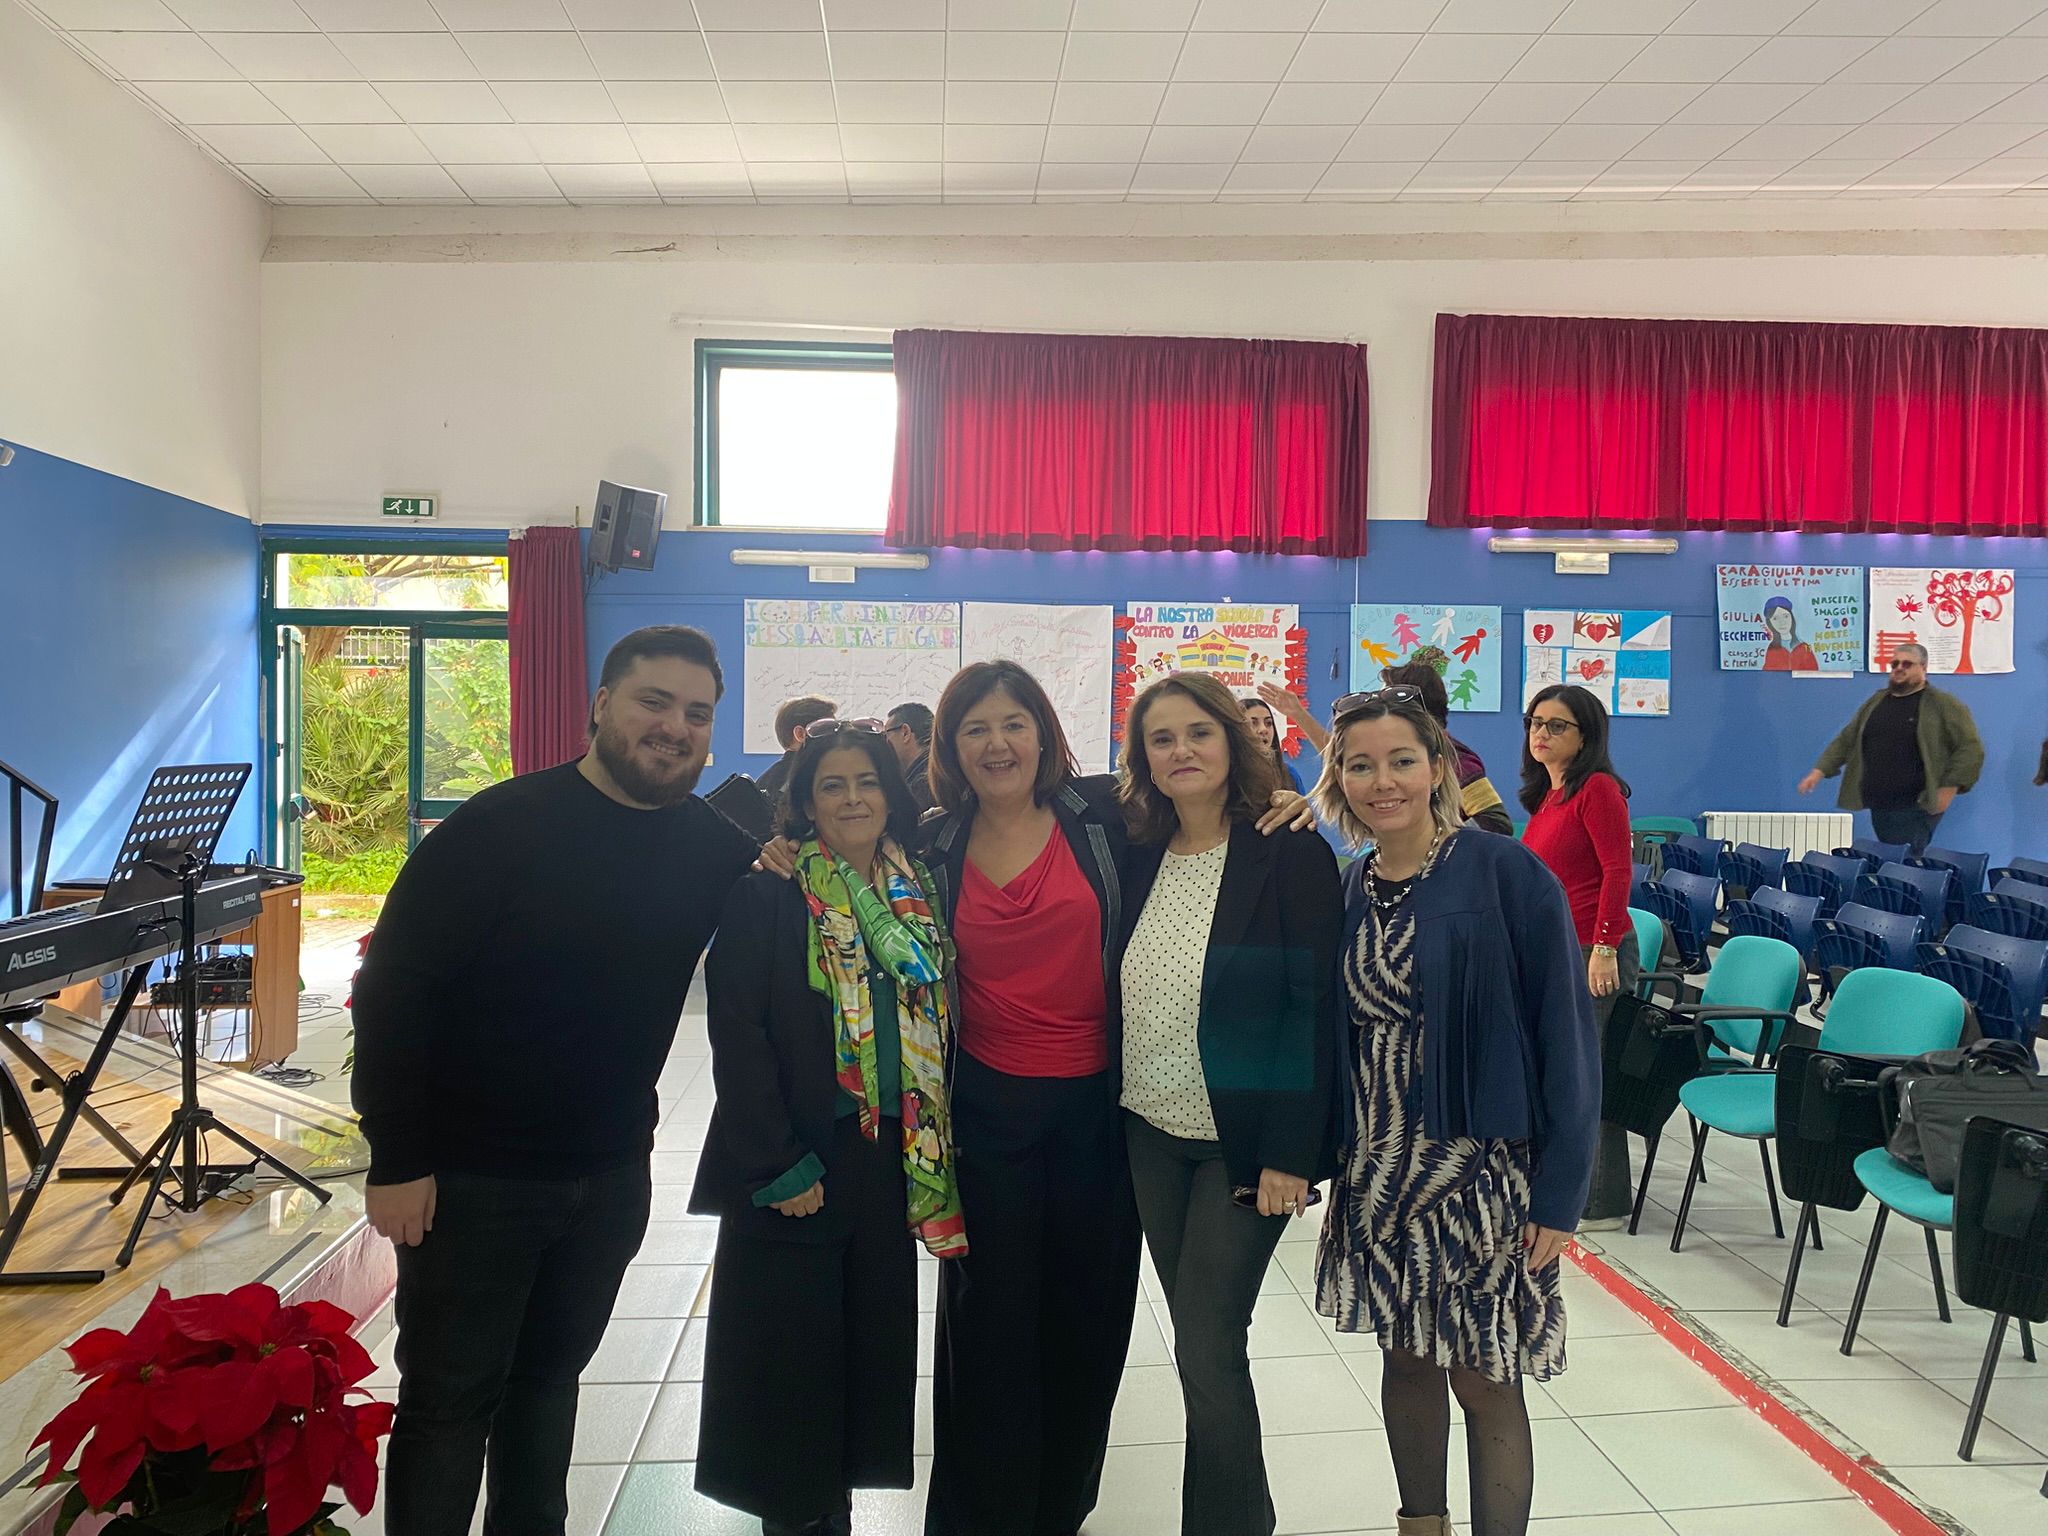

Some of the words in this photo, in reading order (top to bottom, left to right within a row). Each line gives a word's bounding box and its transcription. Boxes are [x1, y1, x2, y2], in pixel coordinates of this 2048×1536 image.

[1718, 564, 1760, 577] CARA
[1761, 566, 1804, 578] GIULIA
[1135, 606, 1153, 623] LA
[1157, 606, 1214, 623] NOSTRA
[1215, 607, 1265, 623] SCUOLA
[1823, 617, 1856, 629] 2001
[1132, 625, 1175, 639] CONTRO
[1182, 625, 1199, 640] LA
[1822, 651, 1852, 663] 2023
[222, 896, 245, 911] RECITAL
[244, 893, 257, 907] PRO
[6, 945, 57, 973] ALESIS
